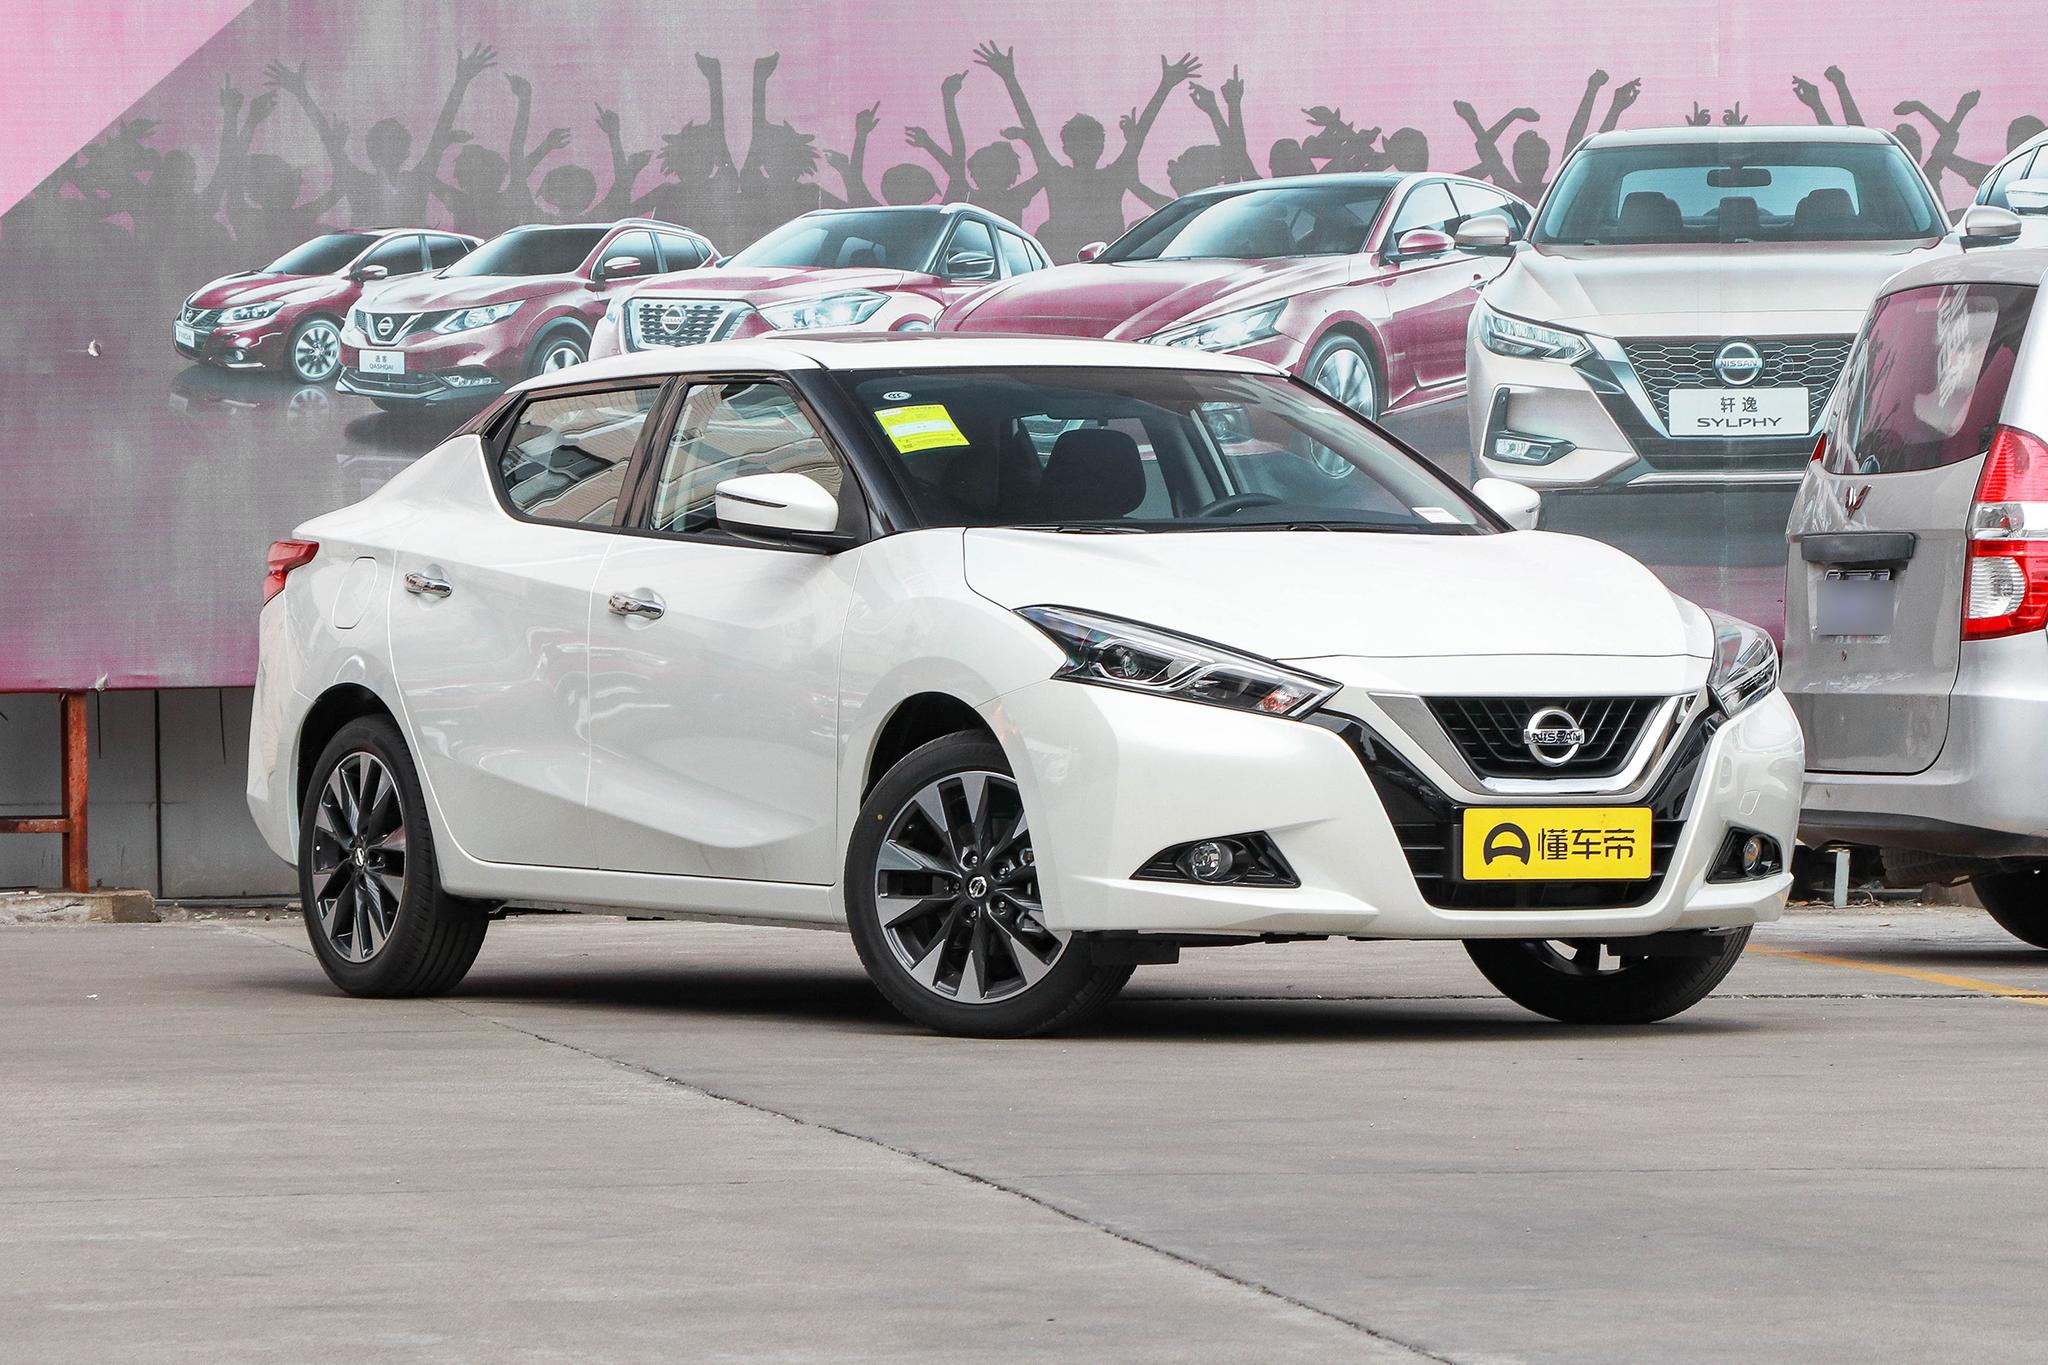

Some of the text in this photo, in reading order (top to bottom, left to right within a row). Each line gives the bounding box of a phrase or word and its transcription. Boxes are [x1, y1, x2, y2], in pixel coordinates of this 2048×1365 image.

[1720, 396, 1758, 413] 轩逸
[1697, 417, 1782, 428] SYLPHY
[1531, 730, 1581, 743] NISSAN
[1537, 828, 1636, 860] 懂车帝
